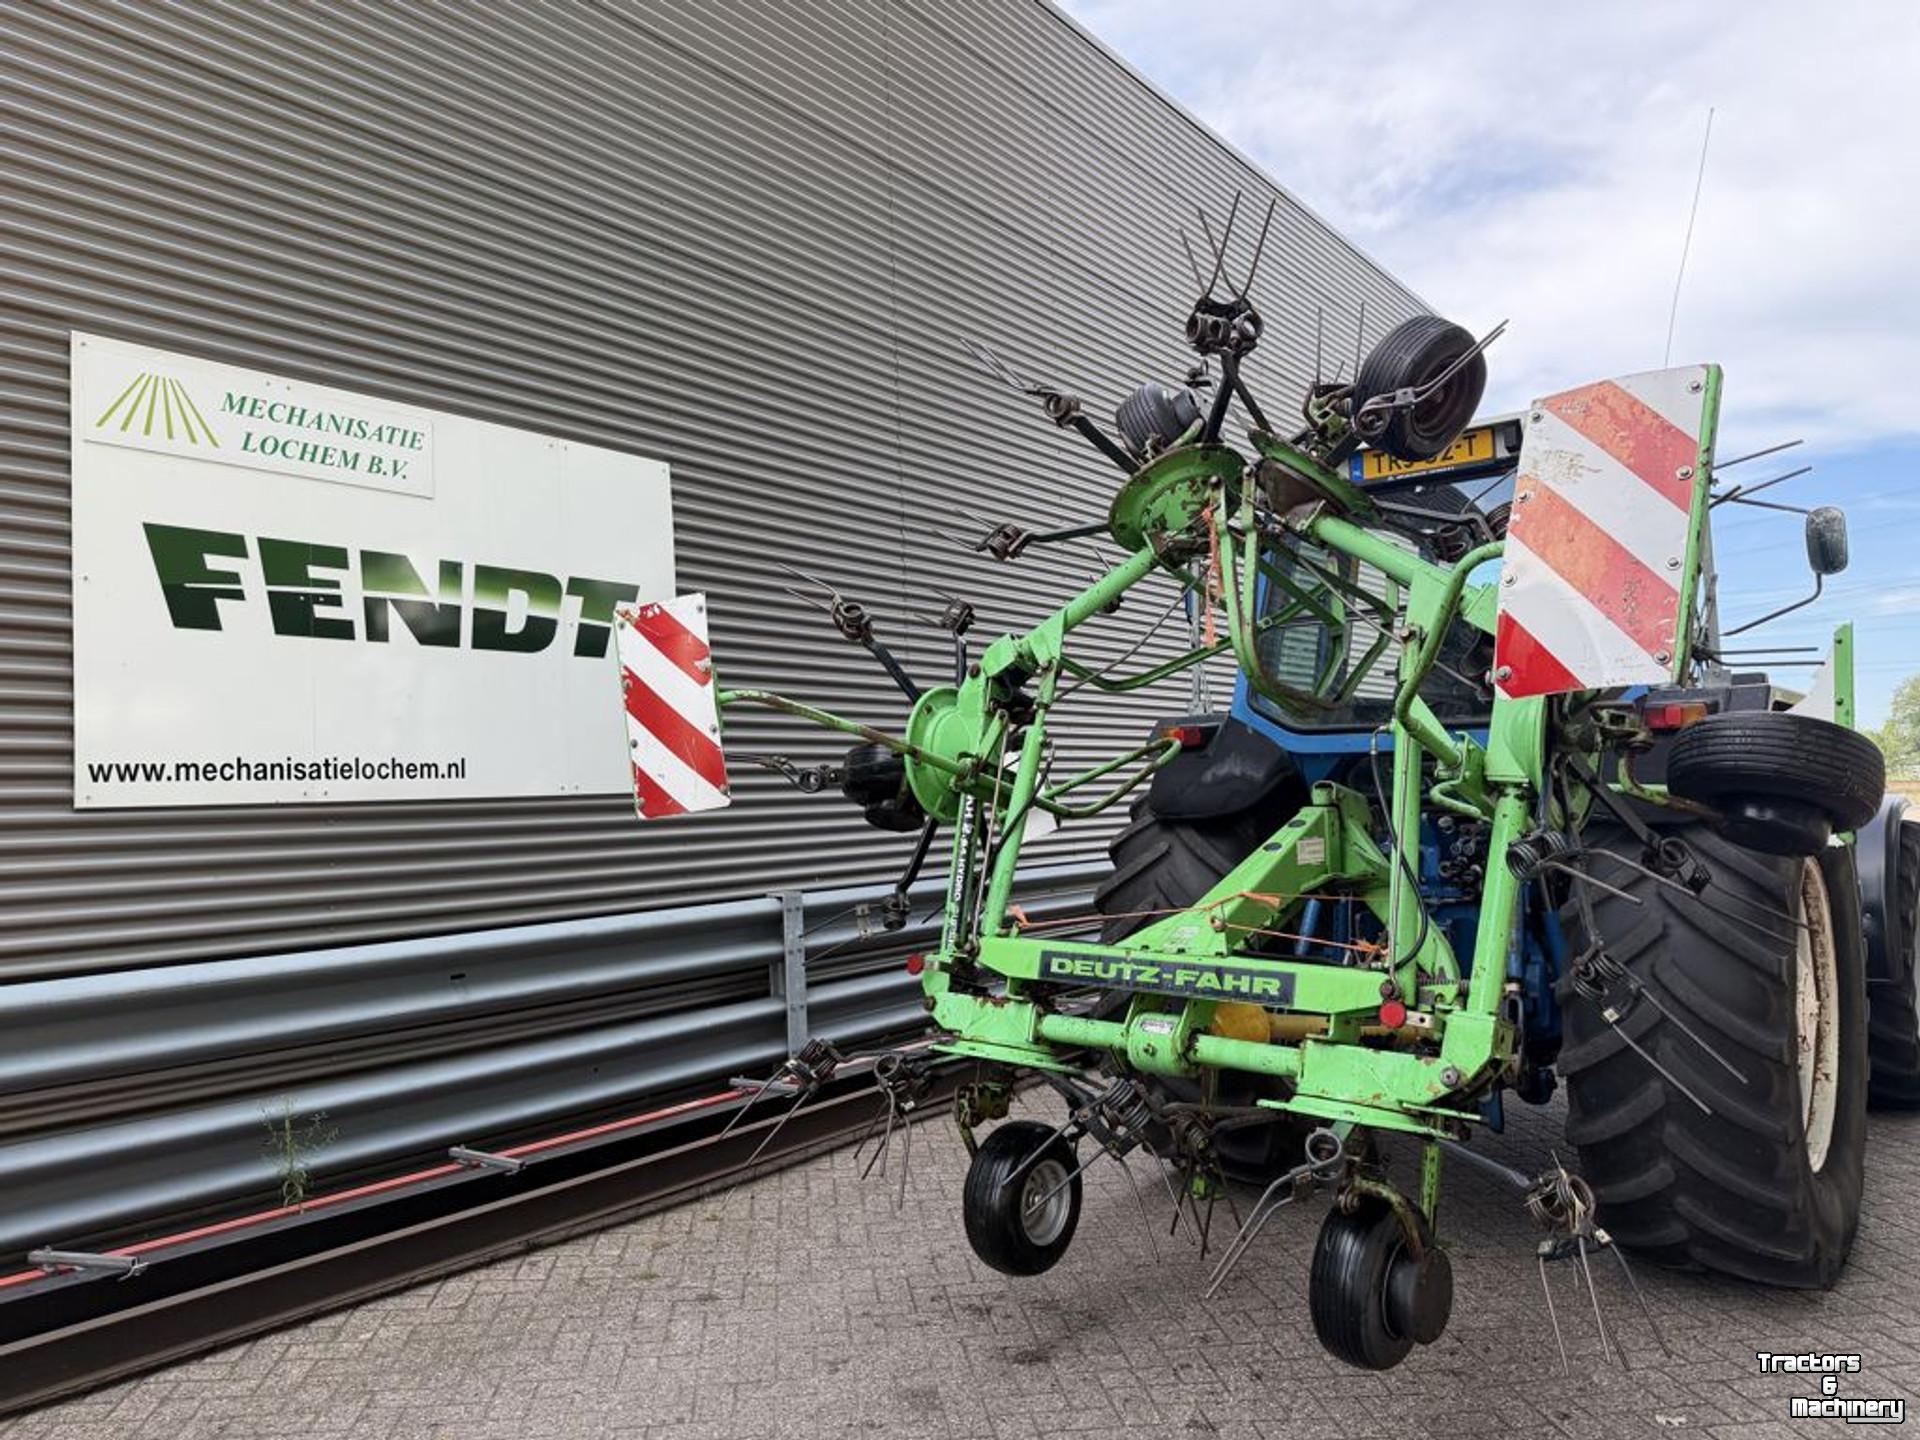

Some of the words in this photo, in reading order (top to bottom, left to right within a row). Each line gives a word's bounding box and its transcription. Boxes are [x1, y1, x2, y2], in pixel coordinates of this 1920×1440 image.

[220, 391, 425, 452] MECHANISATIE
[240, 431, 361, 471] LOCHEM
[366, 454, 409, 480] B.V.
[142, 521, 641, 659] FENDT
[88, 756, 466, 783] www.mechanisatielochem.nl
[1050, 957, 1281, 996] DEUTZ-FAHR
